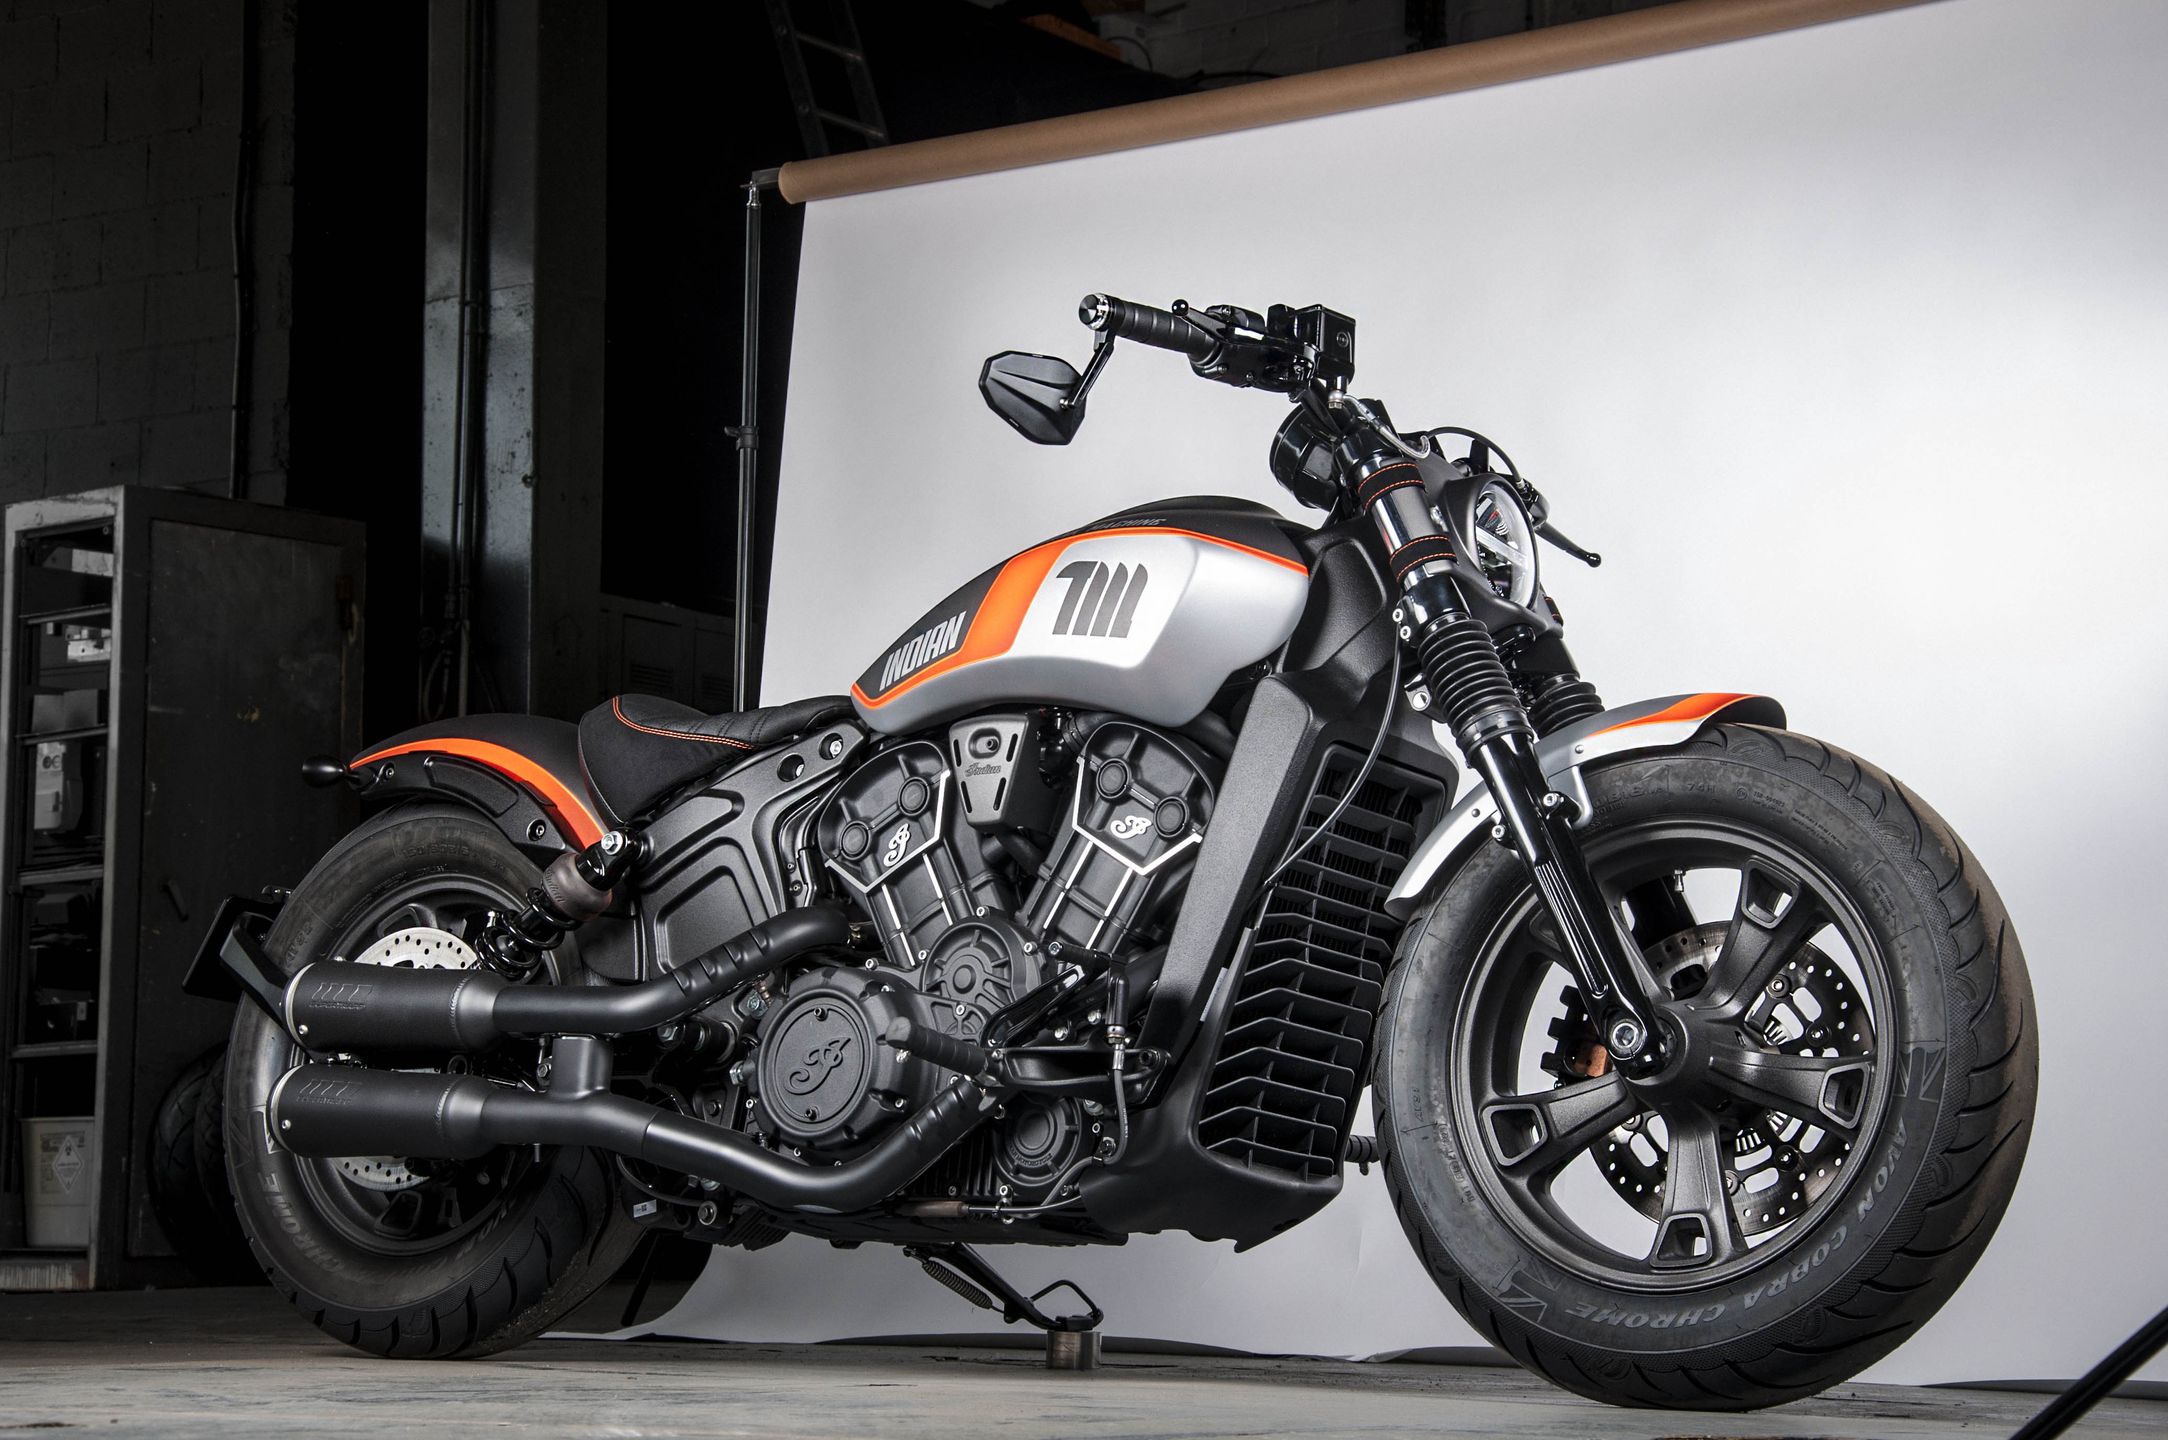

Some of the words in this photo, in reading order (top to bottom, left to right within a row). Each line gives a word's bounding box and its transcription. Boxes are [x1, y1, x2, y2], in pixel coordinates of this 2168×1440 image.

[879, 610, 967, 692] INDIAN
[965, 761, 1002, 777] Indian
[1857, 1117, 1909, 1224] AVON
[1743, 1224, 1849, 1311] COBRA
[1565, 1299, 1727, 1329] CHROME
